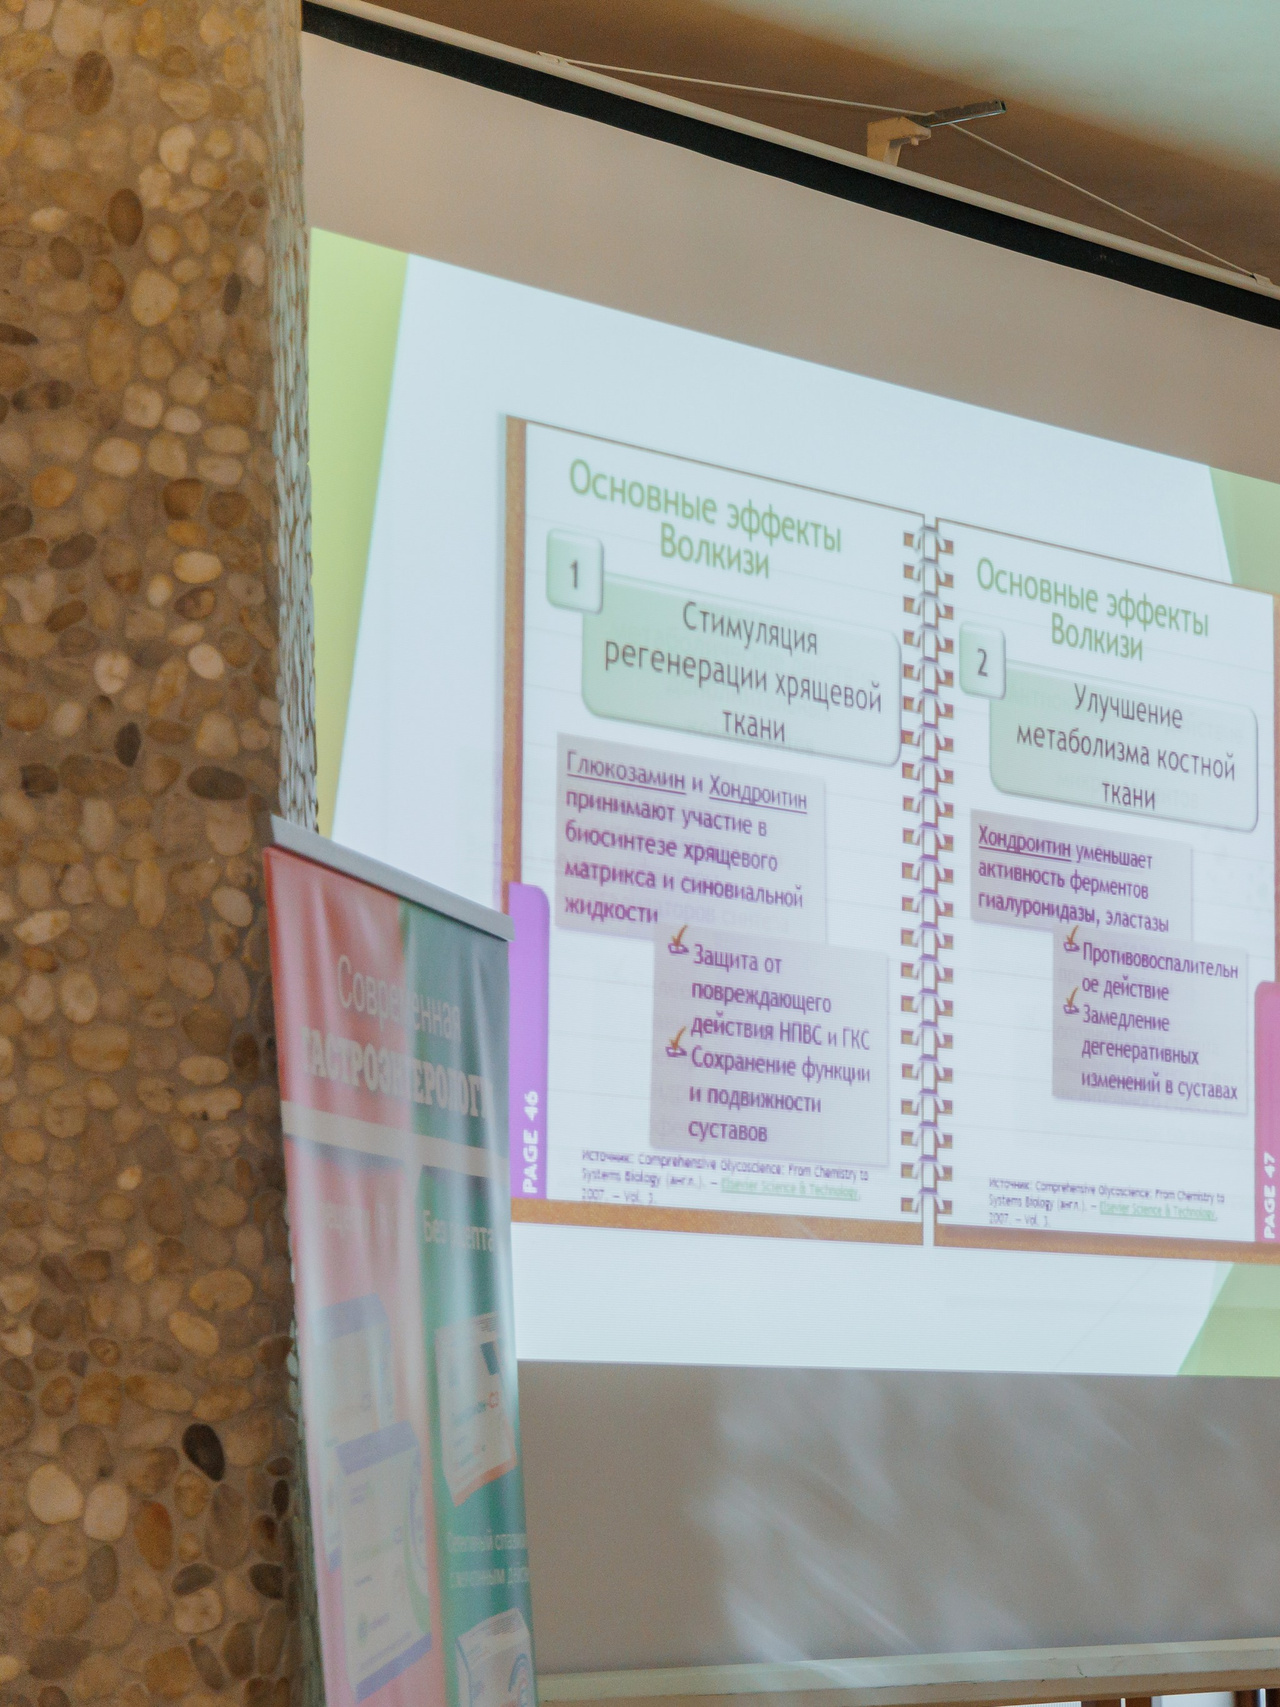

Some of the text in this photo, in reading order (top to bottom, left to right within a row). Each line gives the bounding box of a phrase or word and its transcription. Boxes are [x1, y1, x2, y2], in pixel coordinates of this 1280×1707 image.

[569, 458, 842, 553] Основные эффекты
[660, 522, 770, 579] Волкизи
[569, 559, 579, 590] 1
[976, 557, 1209, 637] Основные эффекты
[682, 600, 818, 655] Стимуляция
[1051, 612, 1143, 662] Волкизи
[604, 640, 883, 713] регенерации хрящевой
[976, 648, 988, 677] 2
[722, 709, 786, 743] ткани
[1074, 683, 1183, 729] Улучшение
[1016, 725, 1235, 782] метаболизма костной
[566, 750, 808, 810] Глюкозамин и Хондроитин
[1102, 781, 1155, 811] ткани
[565, 790, 767, 837] принимают участие в
[565, 819, 778, 872] биосинтезе хрящевого
[978, 824, 1153, 871] Хондроитин уменьшает
[565, 860, 804, 909] матрикса и синовиальной
[978, 860, 1149, 900] активность ферментов
[564, 896, 658, 925] жидкости
[978, 891, 1170, 934] гиалуронидазы, эластазы
[693, 943, 782, 975] Защита от
[1082, 941, 1239, 980] Противовоспалительн
[337, 955, 462, 1044] Совреенная
[691, 981, 832, 1014] повреждающего
[1082, 975, 1169, 1003] ое действие
[690, 1011, 870, 1051] действия НПВС и ГКС
[1082, 1003, 1170, 1032] Замедление
[691, 1044, 871, 1084] Сохранение функции
[1081, 1038, 1200, 1066] дегенеративных
[690, 1085, 821, 1114] и подвижности
[1081, 1070, 1239, 1101] изменений в суставах
[522, 1090, 539, 1194] PAGE 46
[689, 1118, 768, 1143] суставов
[788, 1163, 811, 1176] From
[1155, 1188, 1175, 1199] From
[1263, 1151, 1276, 1239] PAGE 47
